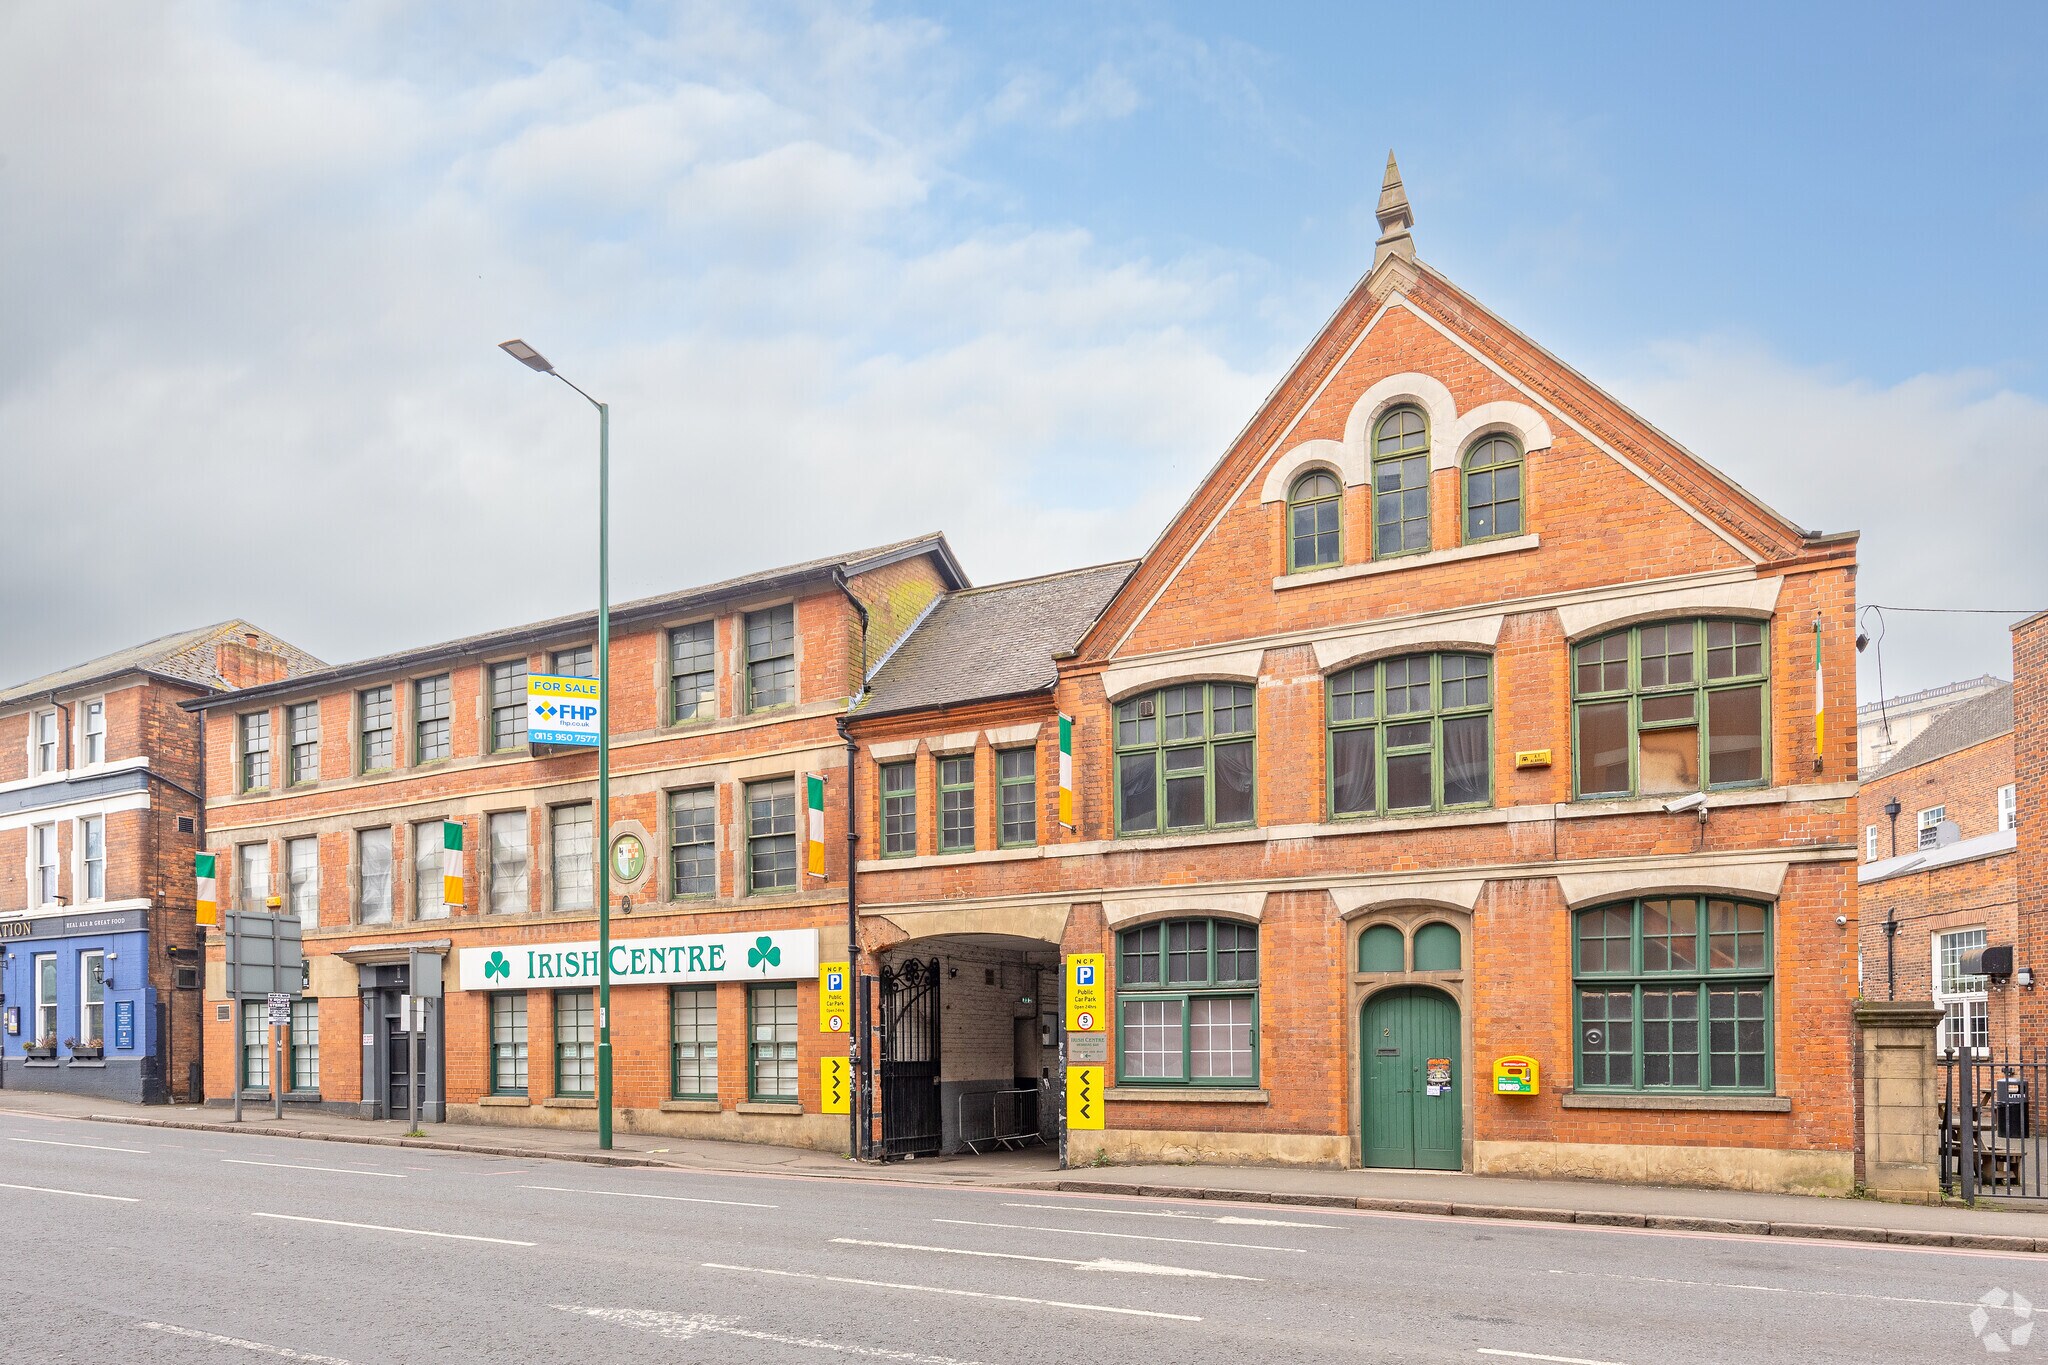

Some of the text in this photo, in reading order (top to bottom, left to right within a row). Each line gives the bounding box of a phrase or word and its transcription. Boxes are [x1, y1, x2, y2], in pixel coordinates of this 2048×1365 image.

[534, 681, 597, 694] FOR SALE
[560, 704, 597, 720] FHP
[534, 732, 598, 743] 0115 950 7577
[527, 944, 727, 979] IRISH CENTRE
[830, 974, 840, 990] P
[1080, 967, 1092, 984] P
[1383, 1027, 1390, 1036] 2
